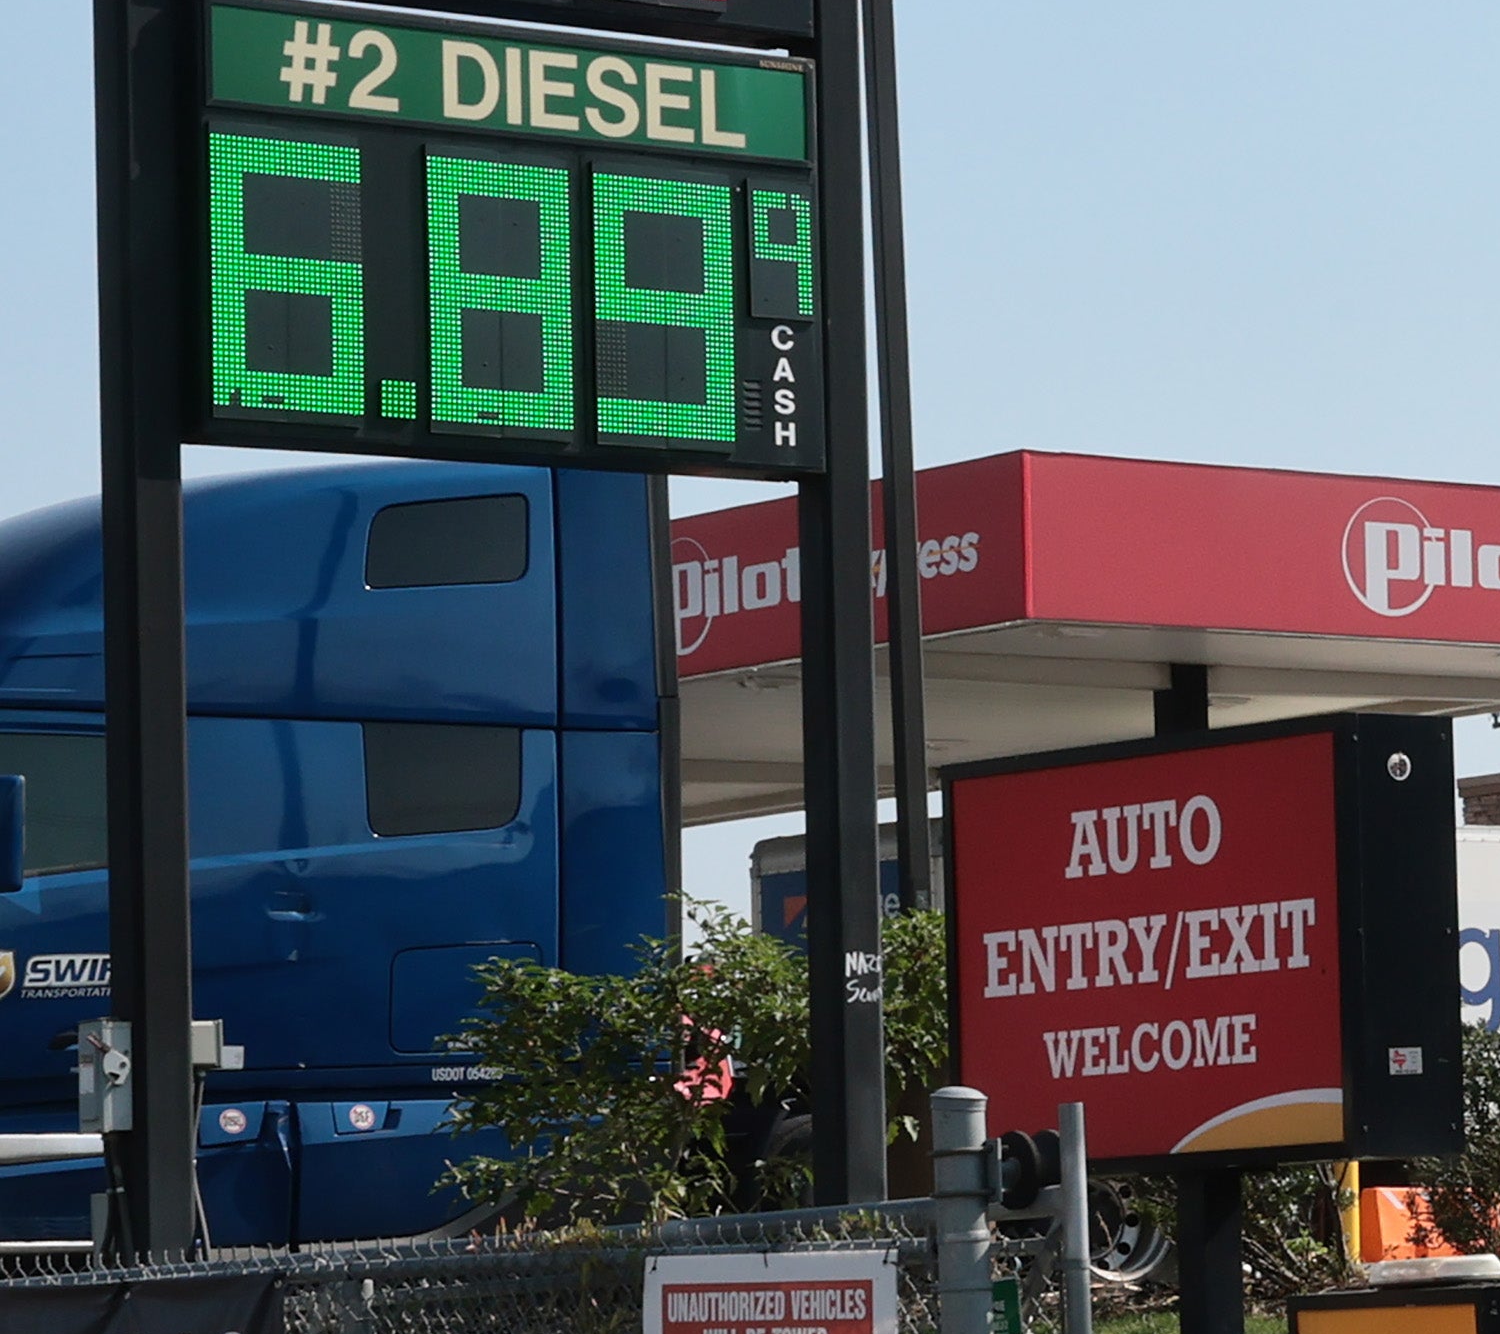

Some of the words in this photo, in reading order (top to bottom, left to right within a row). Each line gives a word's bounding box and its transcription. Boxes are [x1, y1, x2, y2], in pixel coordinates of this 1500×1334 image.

[281, 20, 400, 113] #2
[442, 39, 747, 150] DIESEL
[209, 131, 736, 442] 6.89
[770, 324, 797, 449] CASH
[1065, 794, 1222, 879] AUTO
[21, 987, 112, 999] TRANSPORTATI
[983, 898, 1316, 999] ENTRY/EXIT
[1043, 1013, 1257, 1079] WELCOME
[667, 1290, 786, 1323] UNAUTHORIZED
[791, 1289, 867, 1321] VEHICLES
